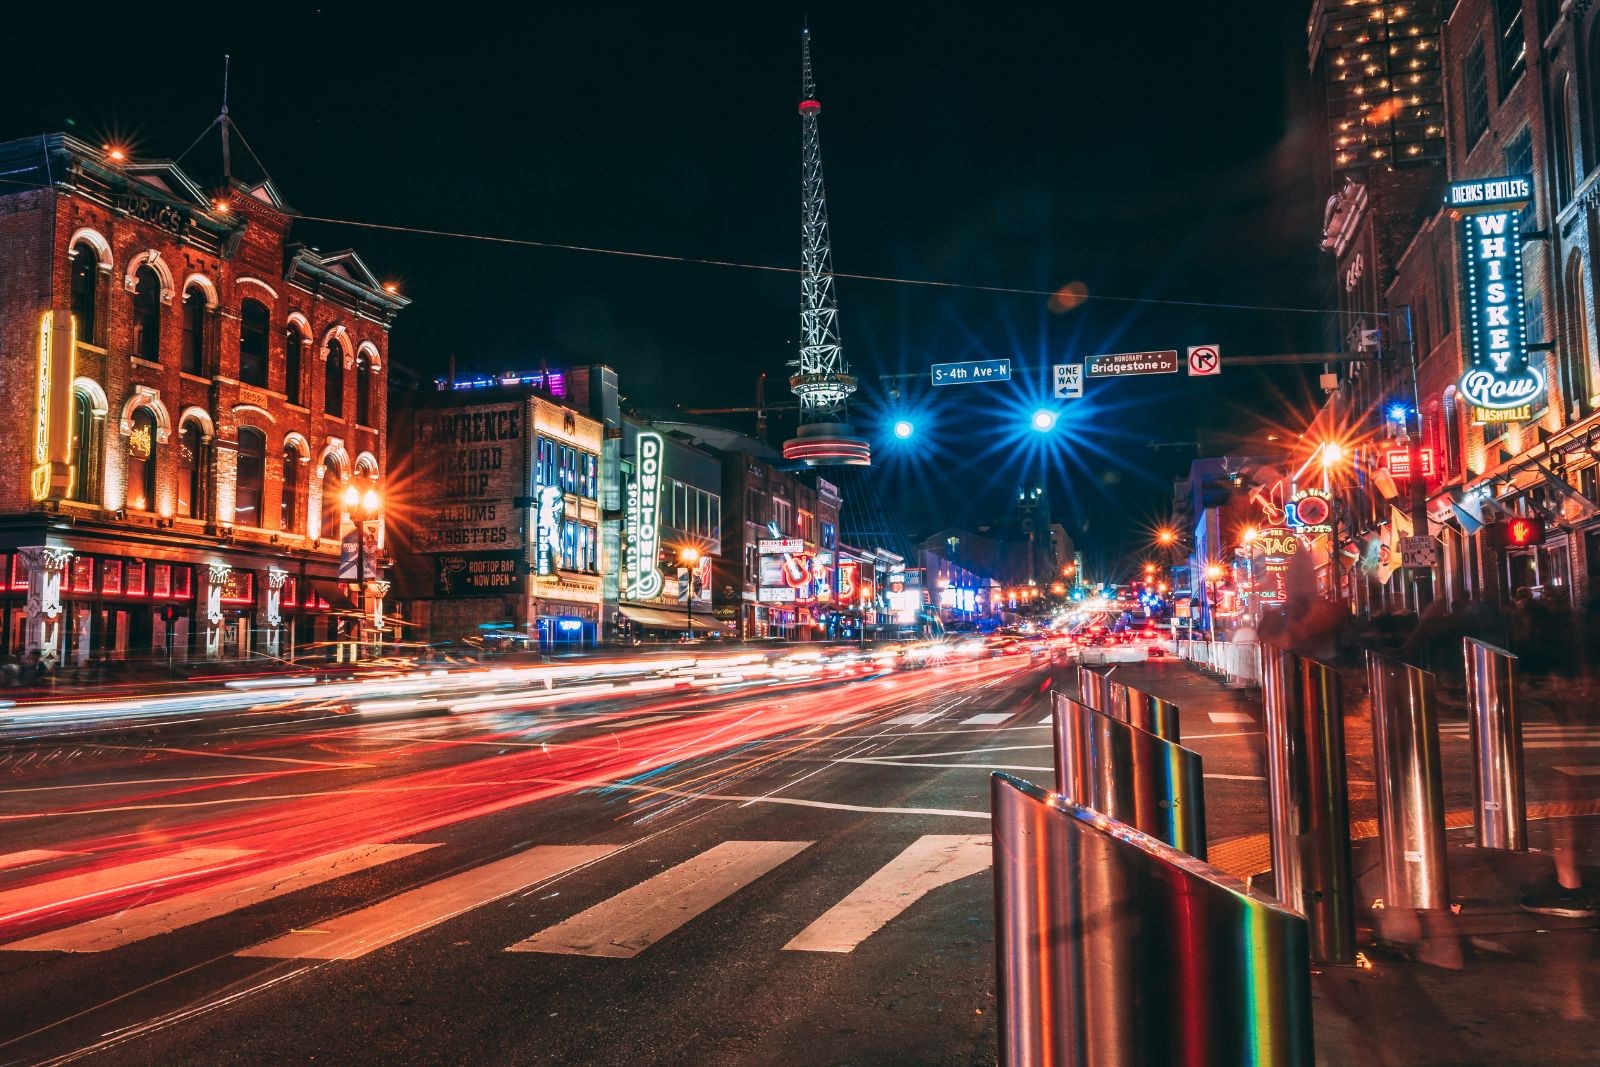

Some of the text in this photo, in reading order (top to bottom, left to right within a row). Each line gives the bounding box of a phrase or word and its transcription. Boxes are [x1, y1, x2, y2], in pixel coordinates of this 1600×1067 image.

[1452, 183, 1483, 204] DIERKS
[1476, 214, 1511, 373] WHISKEY
[1114, 354, 1143, 363] HONORARY
[935, 367, 967, 381] S-4th
[1058, 366, 1078, 376] ONE
[1091, 361, 1172, 374] Bridgestone Dr
[1058, 376, 1079, 385] WAY
[1469, 371, 1536, 405] Row
[1477, 405, 1531, 422] NASHVILLE
[1292, 488, 1332, 501] BIG TIME
[440, 505, 496, 522] ALBUMS
[627, 483, 638, 544] SPORTING
[640, 440, 657, 573] DOWNTOWN
[1296, 525, 1332, 533] BOOTS
[429, 527, 507, 546] CASSETTES
[627, 547, 638, 579] CLUB
[1404, 552, 1416, 563] OK
[469, 561, 499, 573] ROOFTOP
[501, 560, 514, 571] BAR
[474, 574, 509, 586] NOW OPEN
